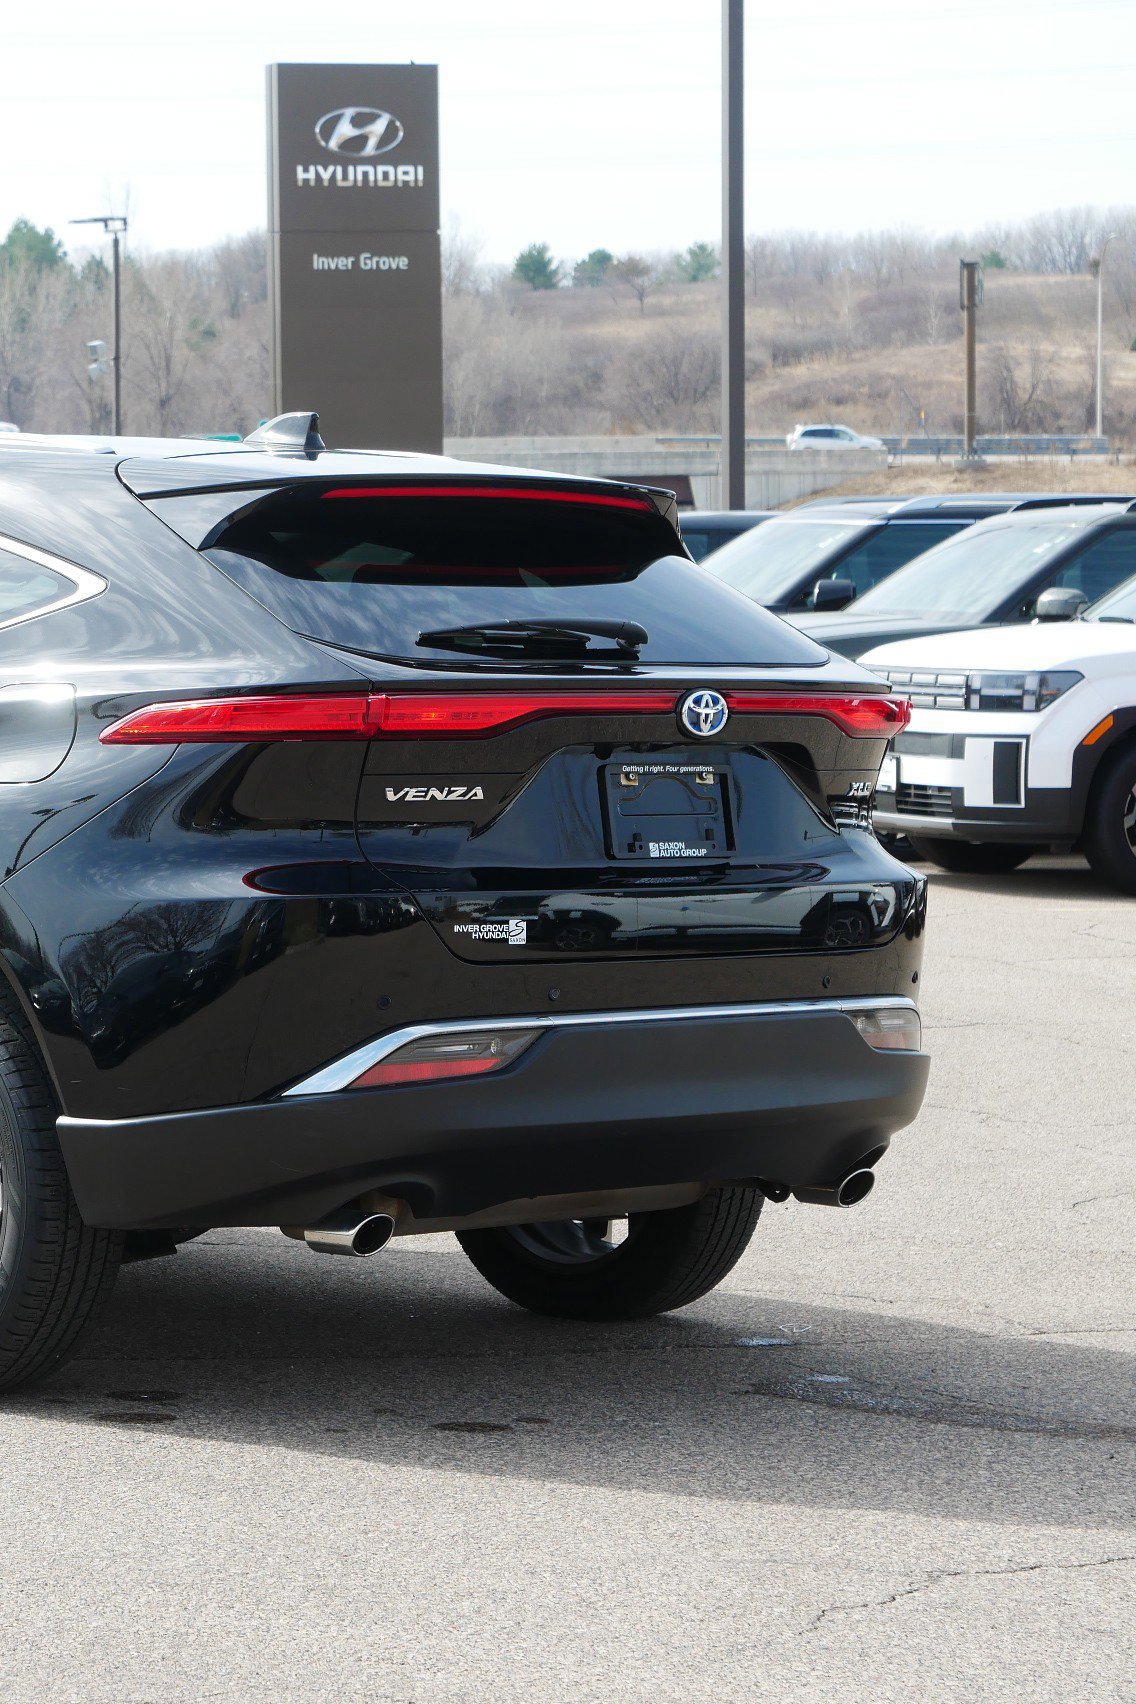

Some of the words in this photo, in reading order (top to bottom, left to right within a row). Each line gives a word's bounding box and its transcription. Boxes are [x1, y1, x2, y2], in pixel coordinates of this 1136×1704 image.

[296, 164, 424, 187] HYUNDAI
[313, 253, 355, 270] Inver
[360, 252, 408, 270] Grove
[622, 765, 644, 773] Getting
[385, 786, 484, 802] VENZA
[659, 842, 685, 850] SAXON
[660, 849, 680, 857] AUTO
[681, 849, 707, 857] GROUP
[453, 924, 480, 932] INVER
[480, 924, 509, 932] GROVE
